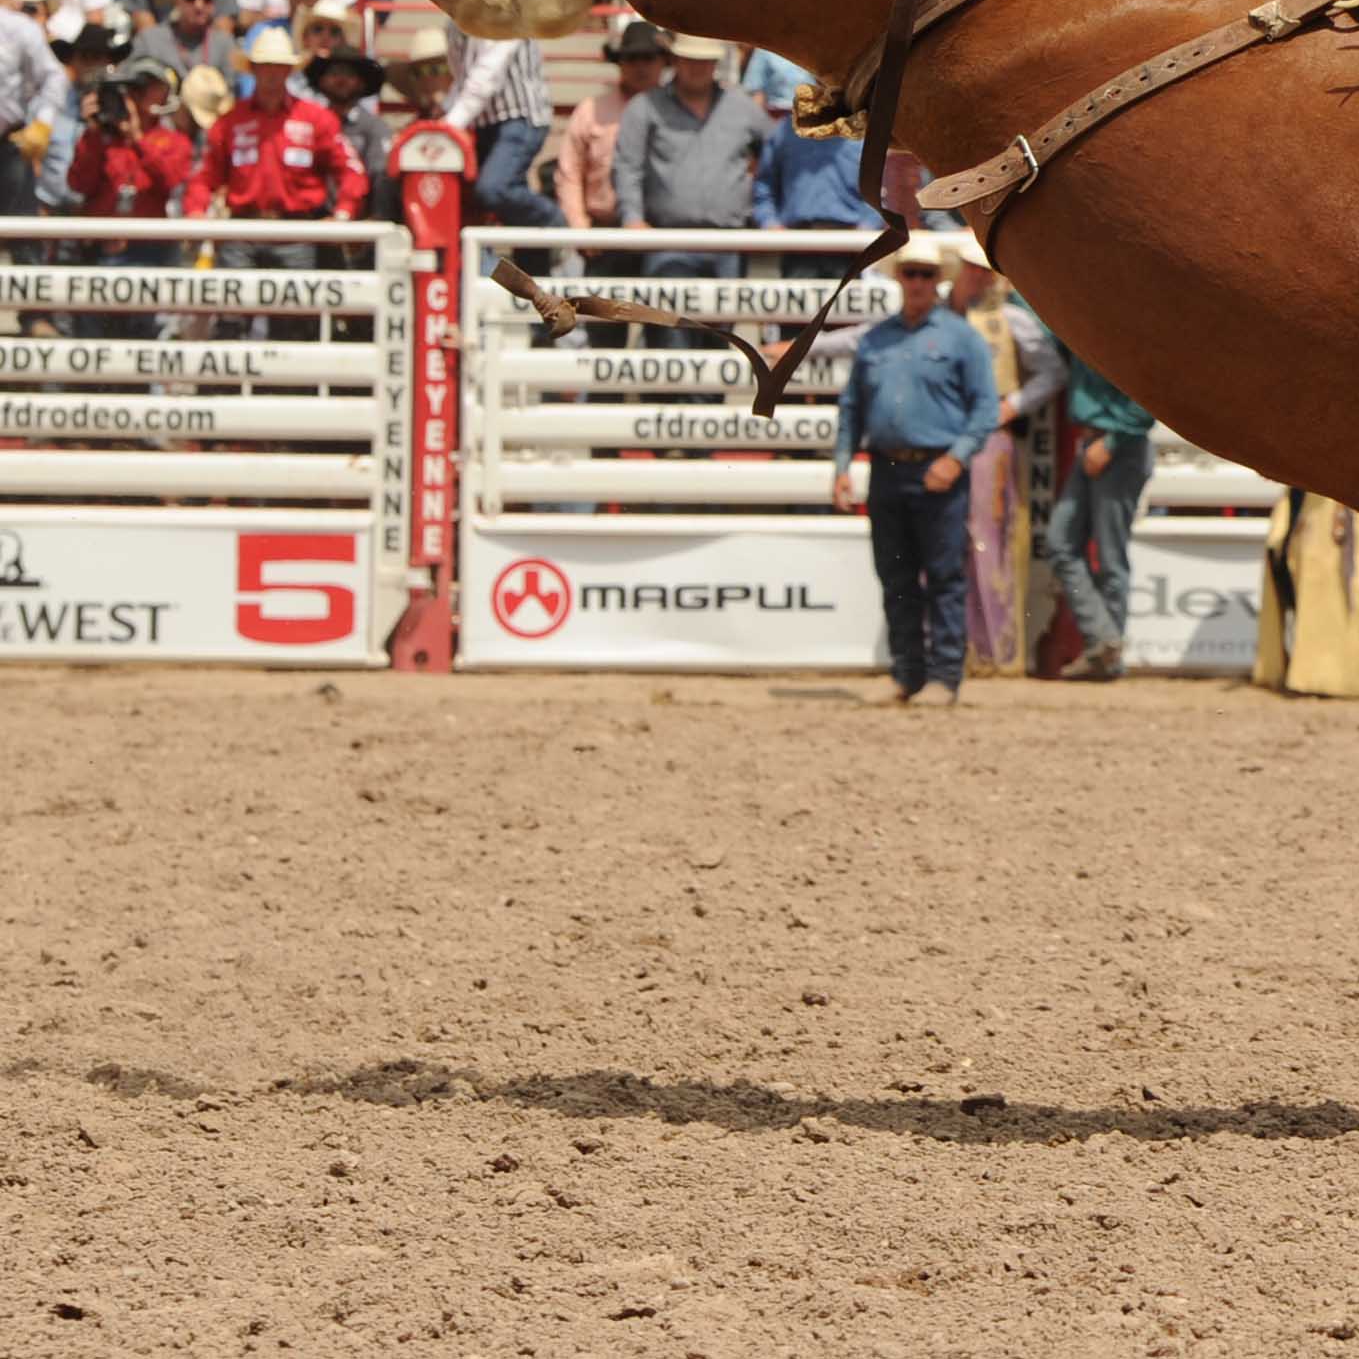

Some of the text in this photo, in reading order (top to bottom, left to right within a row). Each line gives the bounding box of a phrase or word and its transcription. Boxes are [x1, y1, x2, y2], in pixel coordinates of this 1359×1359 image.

[0, 275, 345, 307] NE FRONTIER DAYS
[716, 286, 888, 313] FRONTIER
[68, 347, 111, 371] OF
[384, 282, 405, 552] CHEYENNE
[422, 278, 449, 556] CHEYENNE
[634, 414, 833, 440] cfdrodeo.co
[236, 532, 355, 646] 5
[579, 585, 836, 611] MAGPUL
[18, 602, 171, 642] WEST
